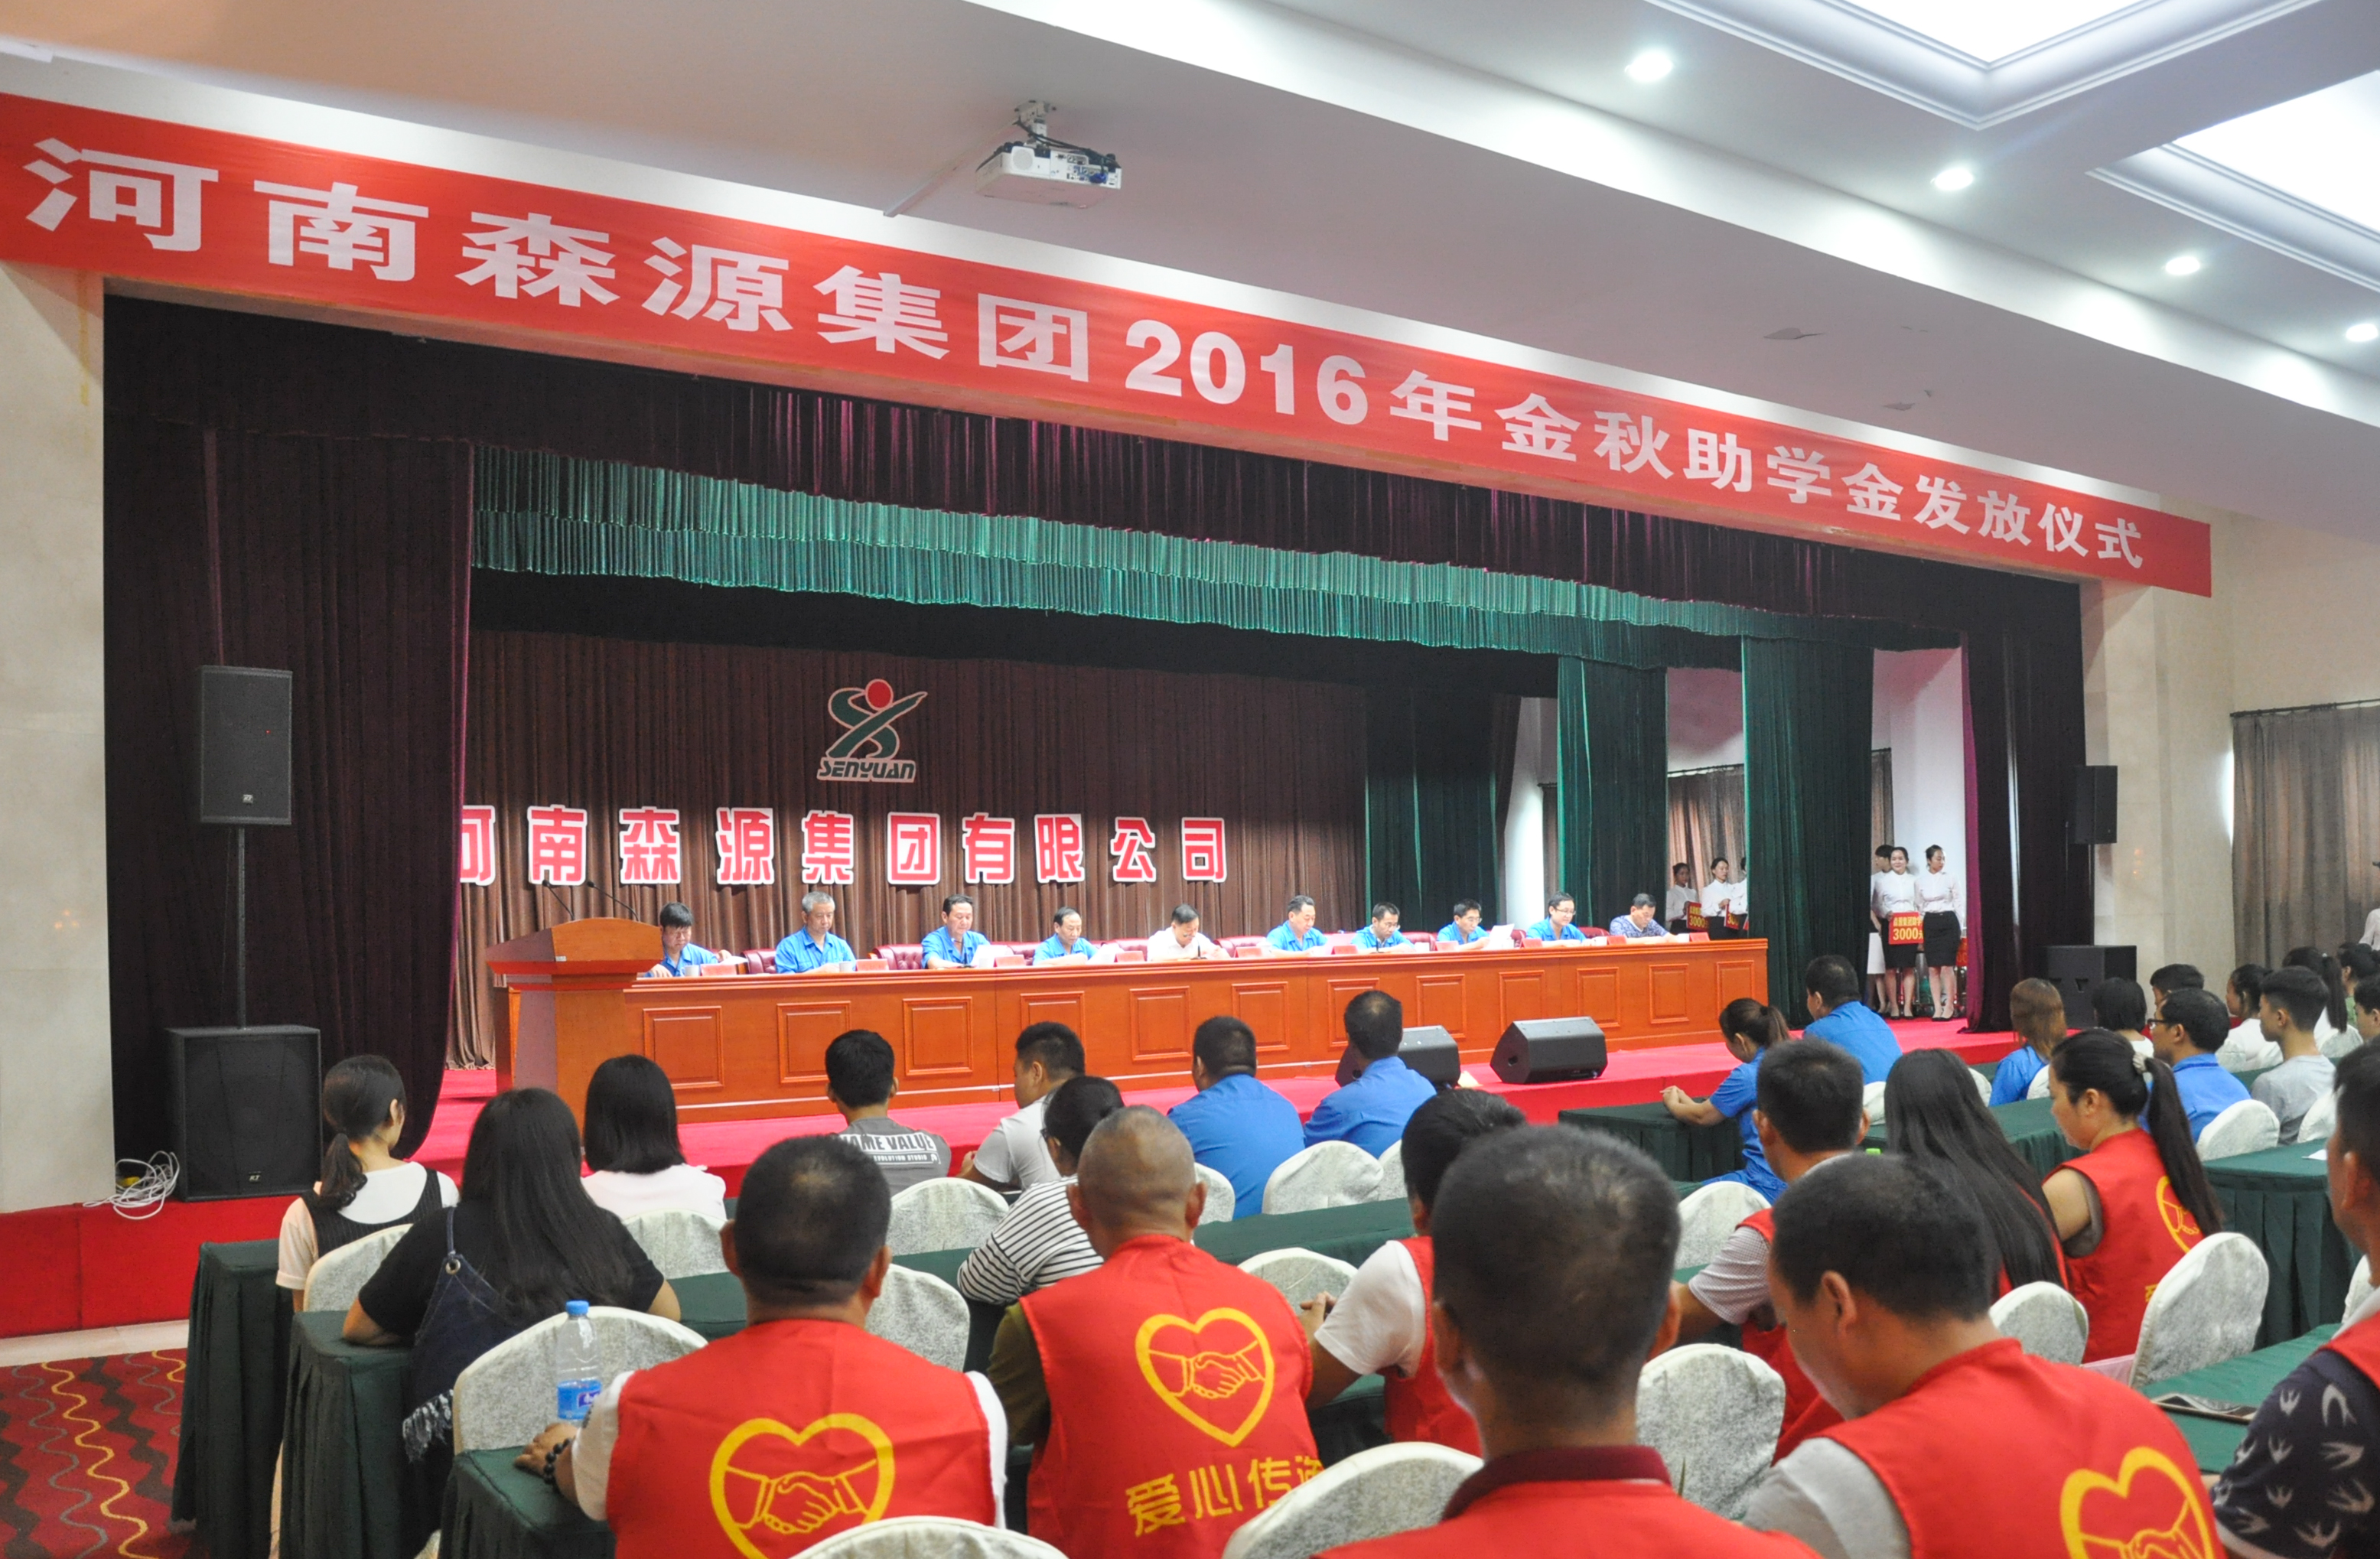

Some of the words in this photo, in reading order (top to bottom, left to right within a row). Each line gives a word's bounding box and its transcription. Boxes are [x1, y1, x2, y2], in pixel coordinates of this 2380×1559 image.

[22, 137, 2144, 568] 河南森源集团2016年金秋助学金发放仪式
[818, 760, 916, 780] SENYUAN
[885, 1132, 934, 1151] VALUE
